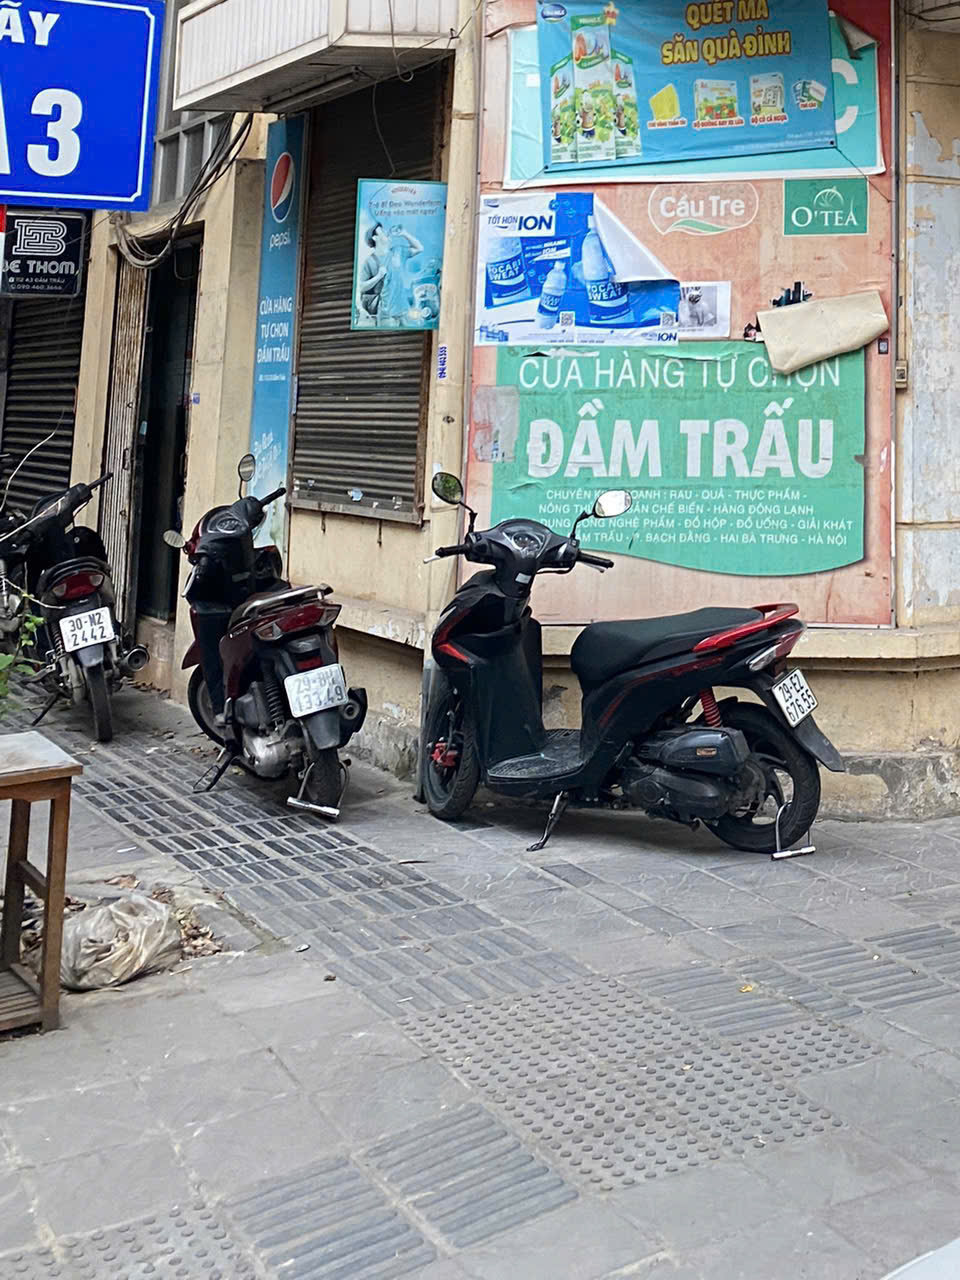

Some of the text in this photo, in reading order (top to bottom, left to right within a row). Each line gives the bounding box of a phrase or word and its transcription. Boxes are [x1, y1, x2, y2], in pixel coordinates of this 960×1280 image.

[661, 25, 792, 66] SĂN QUÀ ĐỈNH
[708, 195, 745, 217] Tre
[518, 215, 553, 231] ION
[269, 228, 291, 252] pepsi
[27, 260, 75, 275] THOM
[595, 351, 685, 388] HÀNG
[748, 356, 840, 392] CỌN
[527, 397, 834, 478] ĐẦM TRẤU
[546, 488, 591, 500] CHUYÊN
[669, 490, 692, 500] RAU
[701, 488, 725, 500] QUẢ
[735, 489, 765, 502] THỰC
[539, 503, 570, 514] NÔNG
[651, 502, 674, 514] CHẾ
[713, 503, 745, 514] HÀNG
[783, 504, 814, 517] LẠNH
[823, 519, 853, 531] KHÁT
[594, 530, 623, 543] TRẤU
[646, 532, 676, 545] BẠCH
[720, 533, 739, 543] HAI
[742, 531, 756, 543] BÀ
[808, 531, 824, 544] HÀ
[827, 532, 847, 546] NỘI
[71, 626, 106, 647] 2442
[786, 689, 816, 722] 676.55
